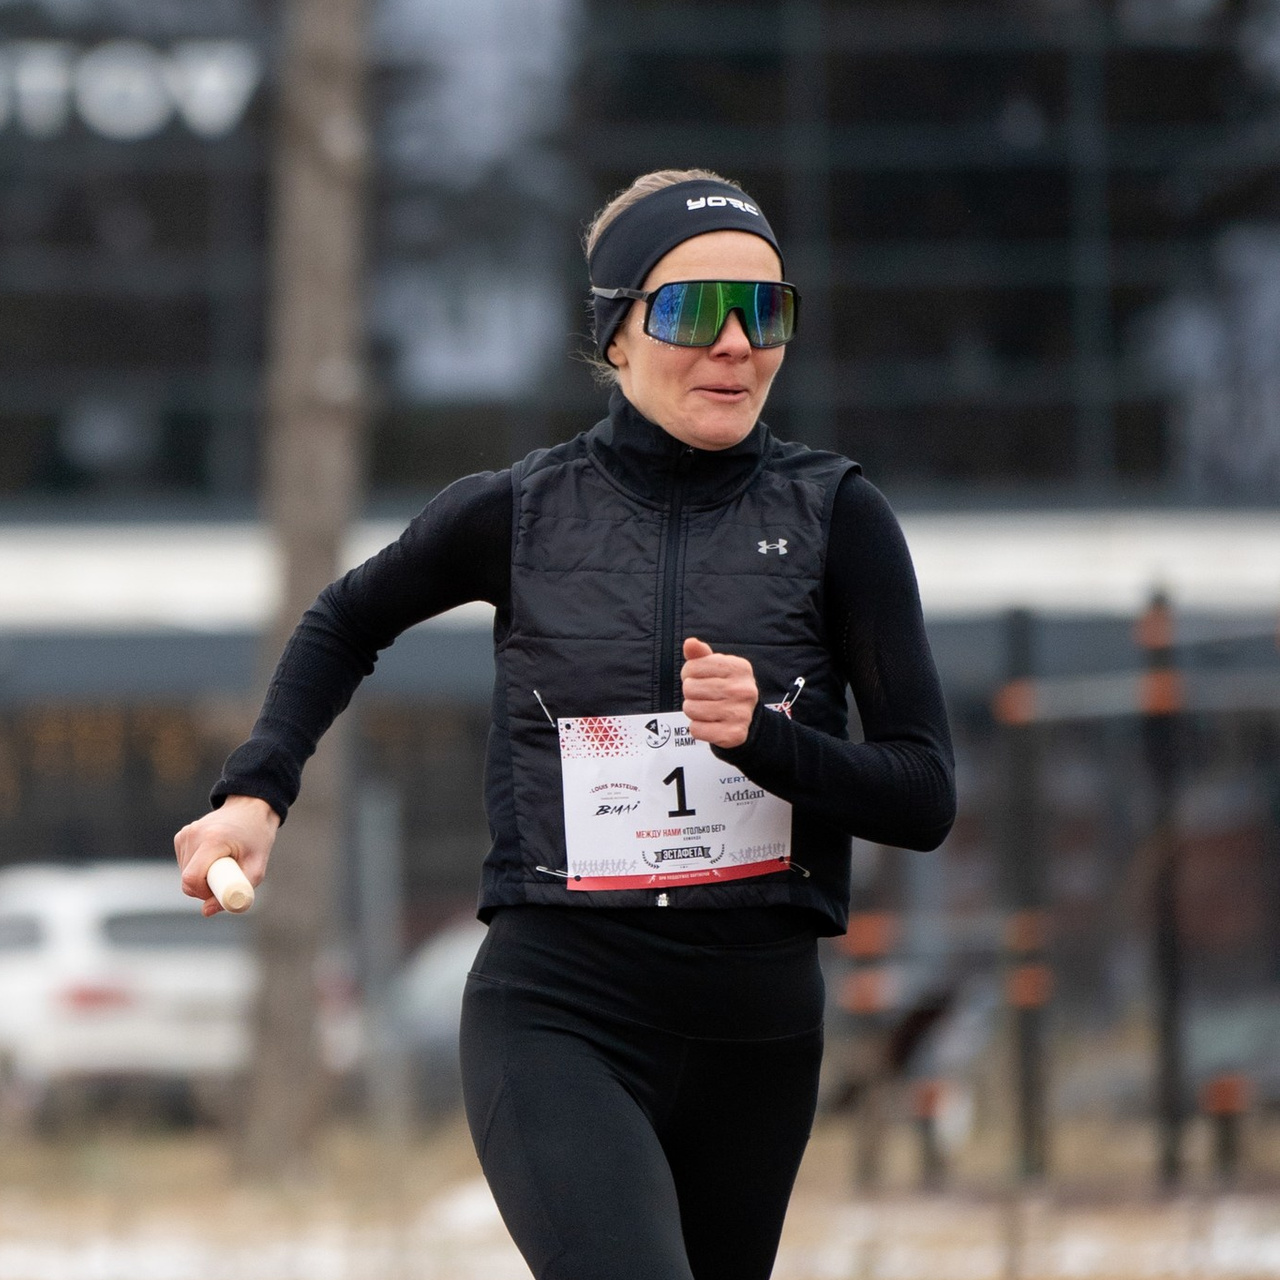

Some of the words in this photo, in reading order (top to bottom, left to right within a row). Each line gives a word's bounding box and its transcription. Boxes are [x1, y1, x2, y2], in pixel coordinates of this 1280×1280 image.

[674, 726, 691, 736] МЕЖ
[675, 737, 696, 747] НАМИ
[719, 776, 750, 785] VERT
[591, 783, 609, 794] LOUIS
[610, 782, 638, 792] PASTEUR
[662, 766, 696, 818] 1
[723, 788, 765, 803] Adrian
[636, 829, 662, 839] МЕЖДУ
[662, 827, 681, 837] НАМИ
[682, 825, 710, 835] «ТОЛЬКО
[711, 823, 726, 833] БЕГ»
[662, 847, 703, 860] ЭСТАФЕТА
